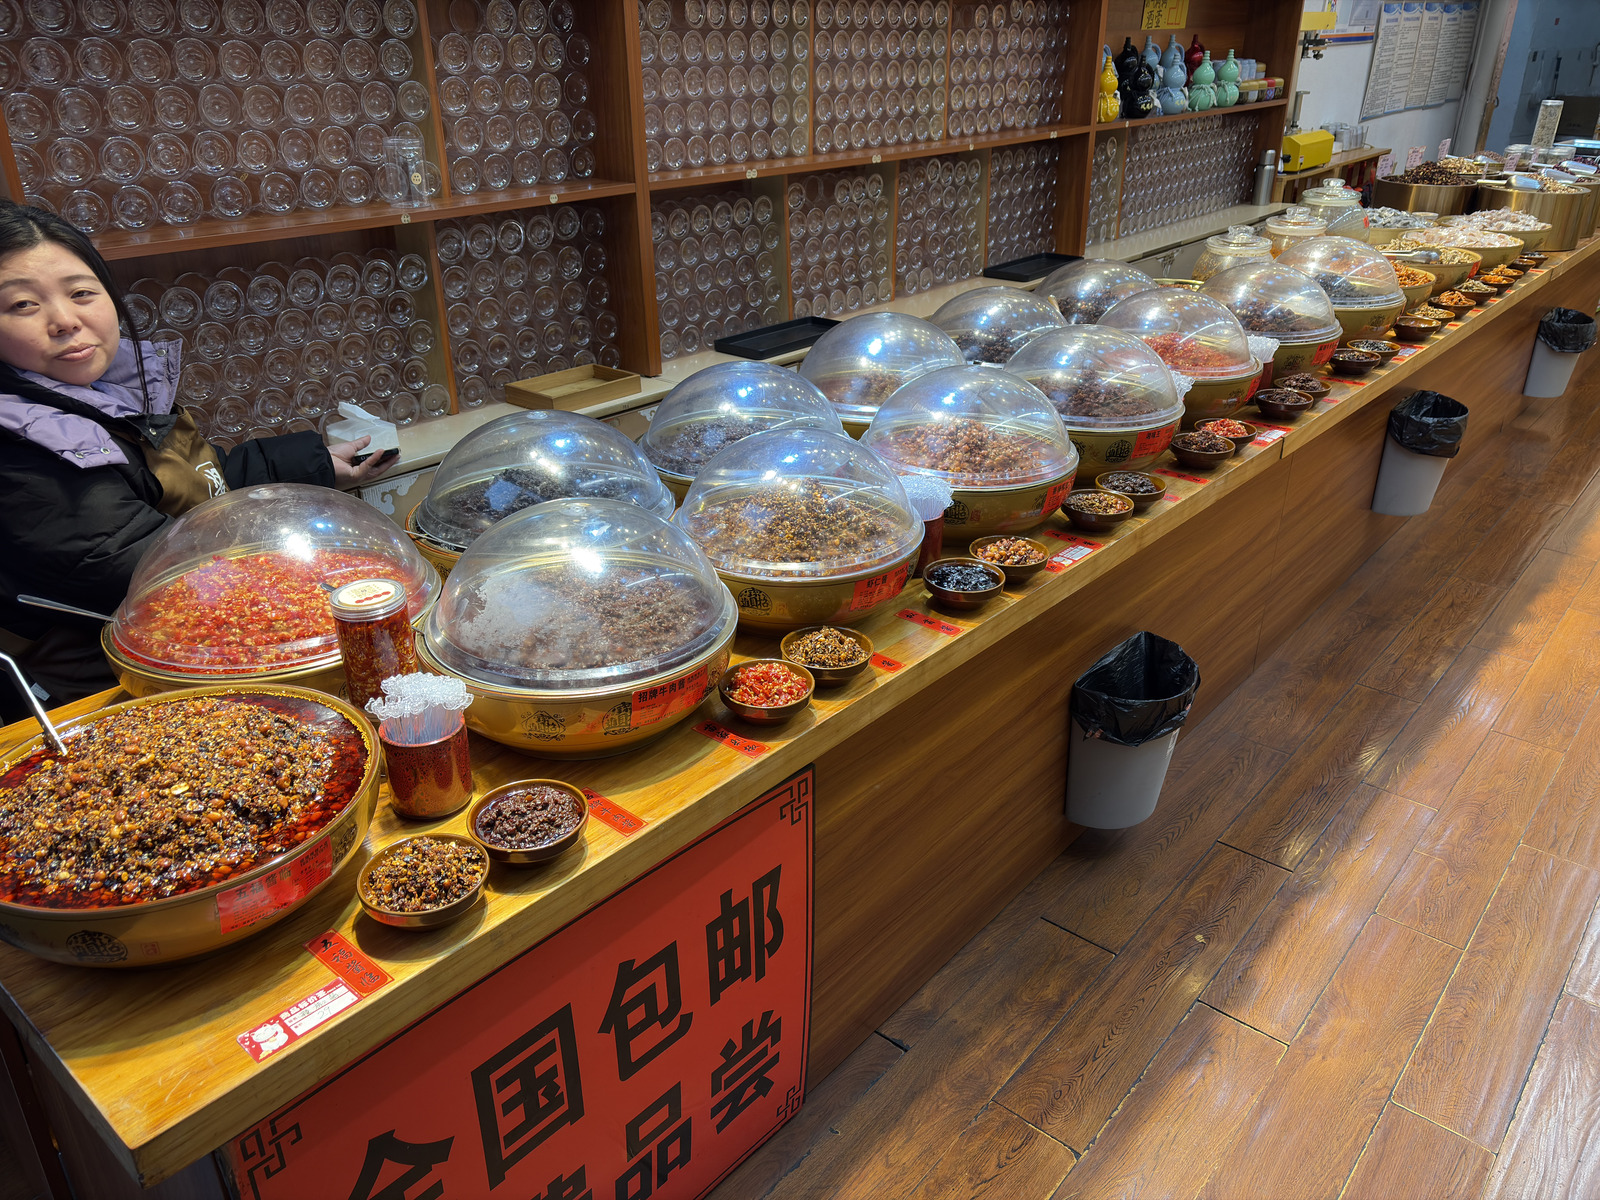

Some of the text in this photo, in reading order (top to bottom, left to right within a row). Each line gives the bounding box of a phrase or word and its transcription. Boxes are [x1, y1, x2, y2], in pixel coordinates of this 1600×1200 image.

[638, 678, 686, 703] 招牌牛肉酱
[346, 864, 784, 1200] 全国包邮
